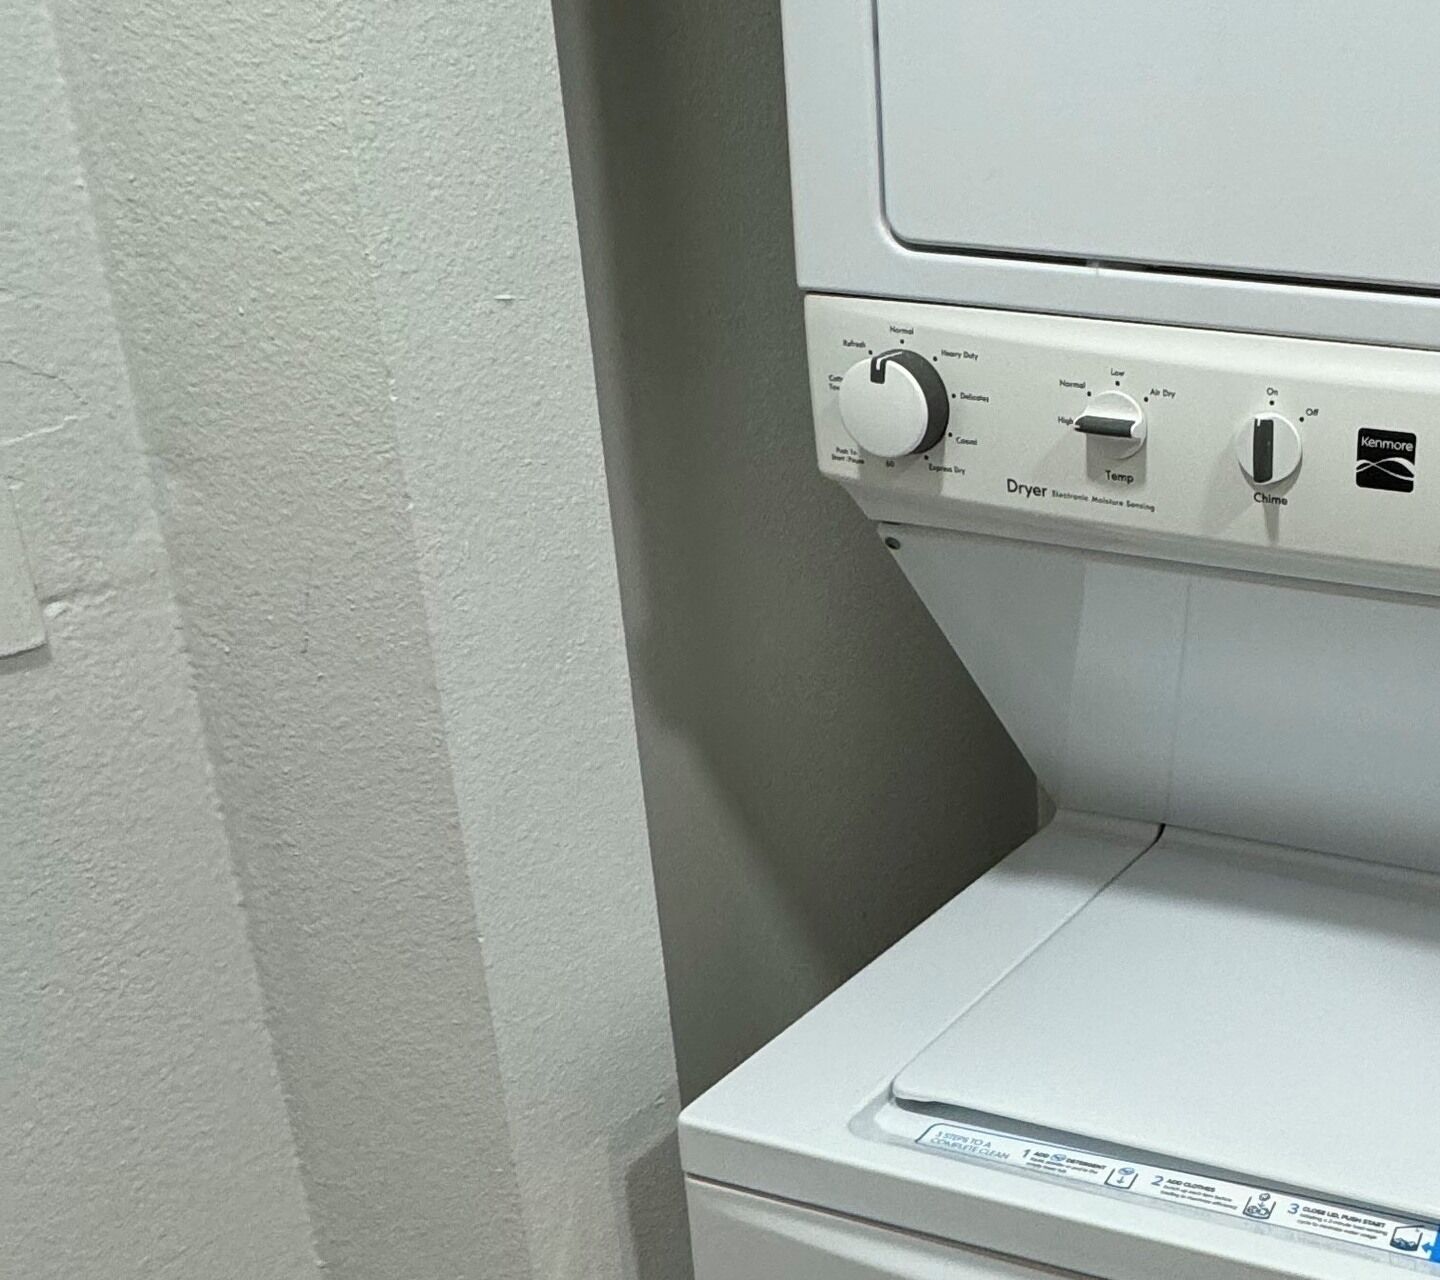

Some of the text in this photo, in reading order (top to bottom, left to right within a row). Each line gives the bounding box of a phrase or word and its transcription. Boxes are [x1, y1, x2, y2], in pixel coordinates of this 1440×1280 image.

[890, 326, 914, 335] Normal
[843, 339, 866, 348] Refresh
[941, 349, 979, 361] Heavy Duty
[1111, 368, 1125, 377] Low
[1059, 380, 1086, 389] Normal
[1150, 388, 1176, 399] Air Dry
[1266, 387, 1278, 396] On
[1305, 408, 1319, 416] Off
[1058, 416, 1074, 426] High
[1361, 436, 1414, 452] Kenmore
[929, 463, 966, 475] Express Dry
[1105, 470, 1134, 484] Temp
[1007, 478, 1155, 512] Dryer Electronic Moisture Sensing
[1253, 492, 1288, 505] Chime
[971, 1137, 984, 1146] TO
[978, 1147, 1009, 1159] CLEAN
[1022, 1148, 1031, 1159] 1
[1151, 1175, 1164, 1186] 2
[1288, 1203, 1299, 1214] 3
[1341, 1214, 1362, 1224] PUSH
[1362, 1219, 1387, 1229] START
